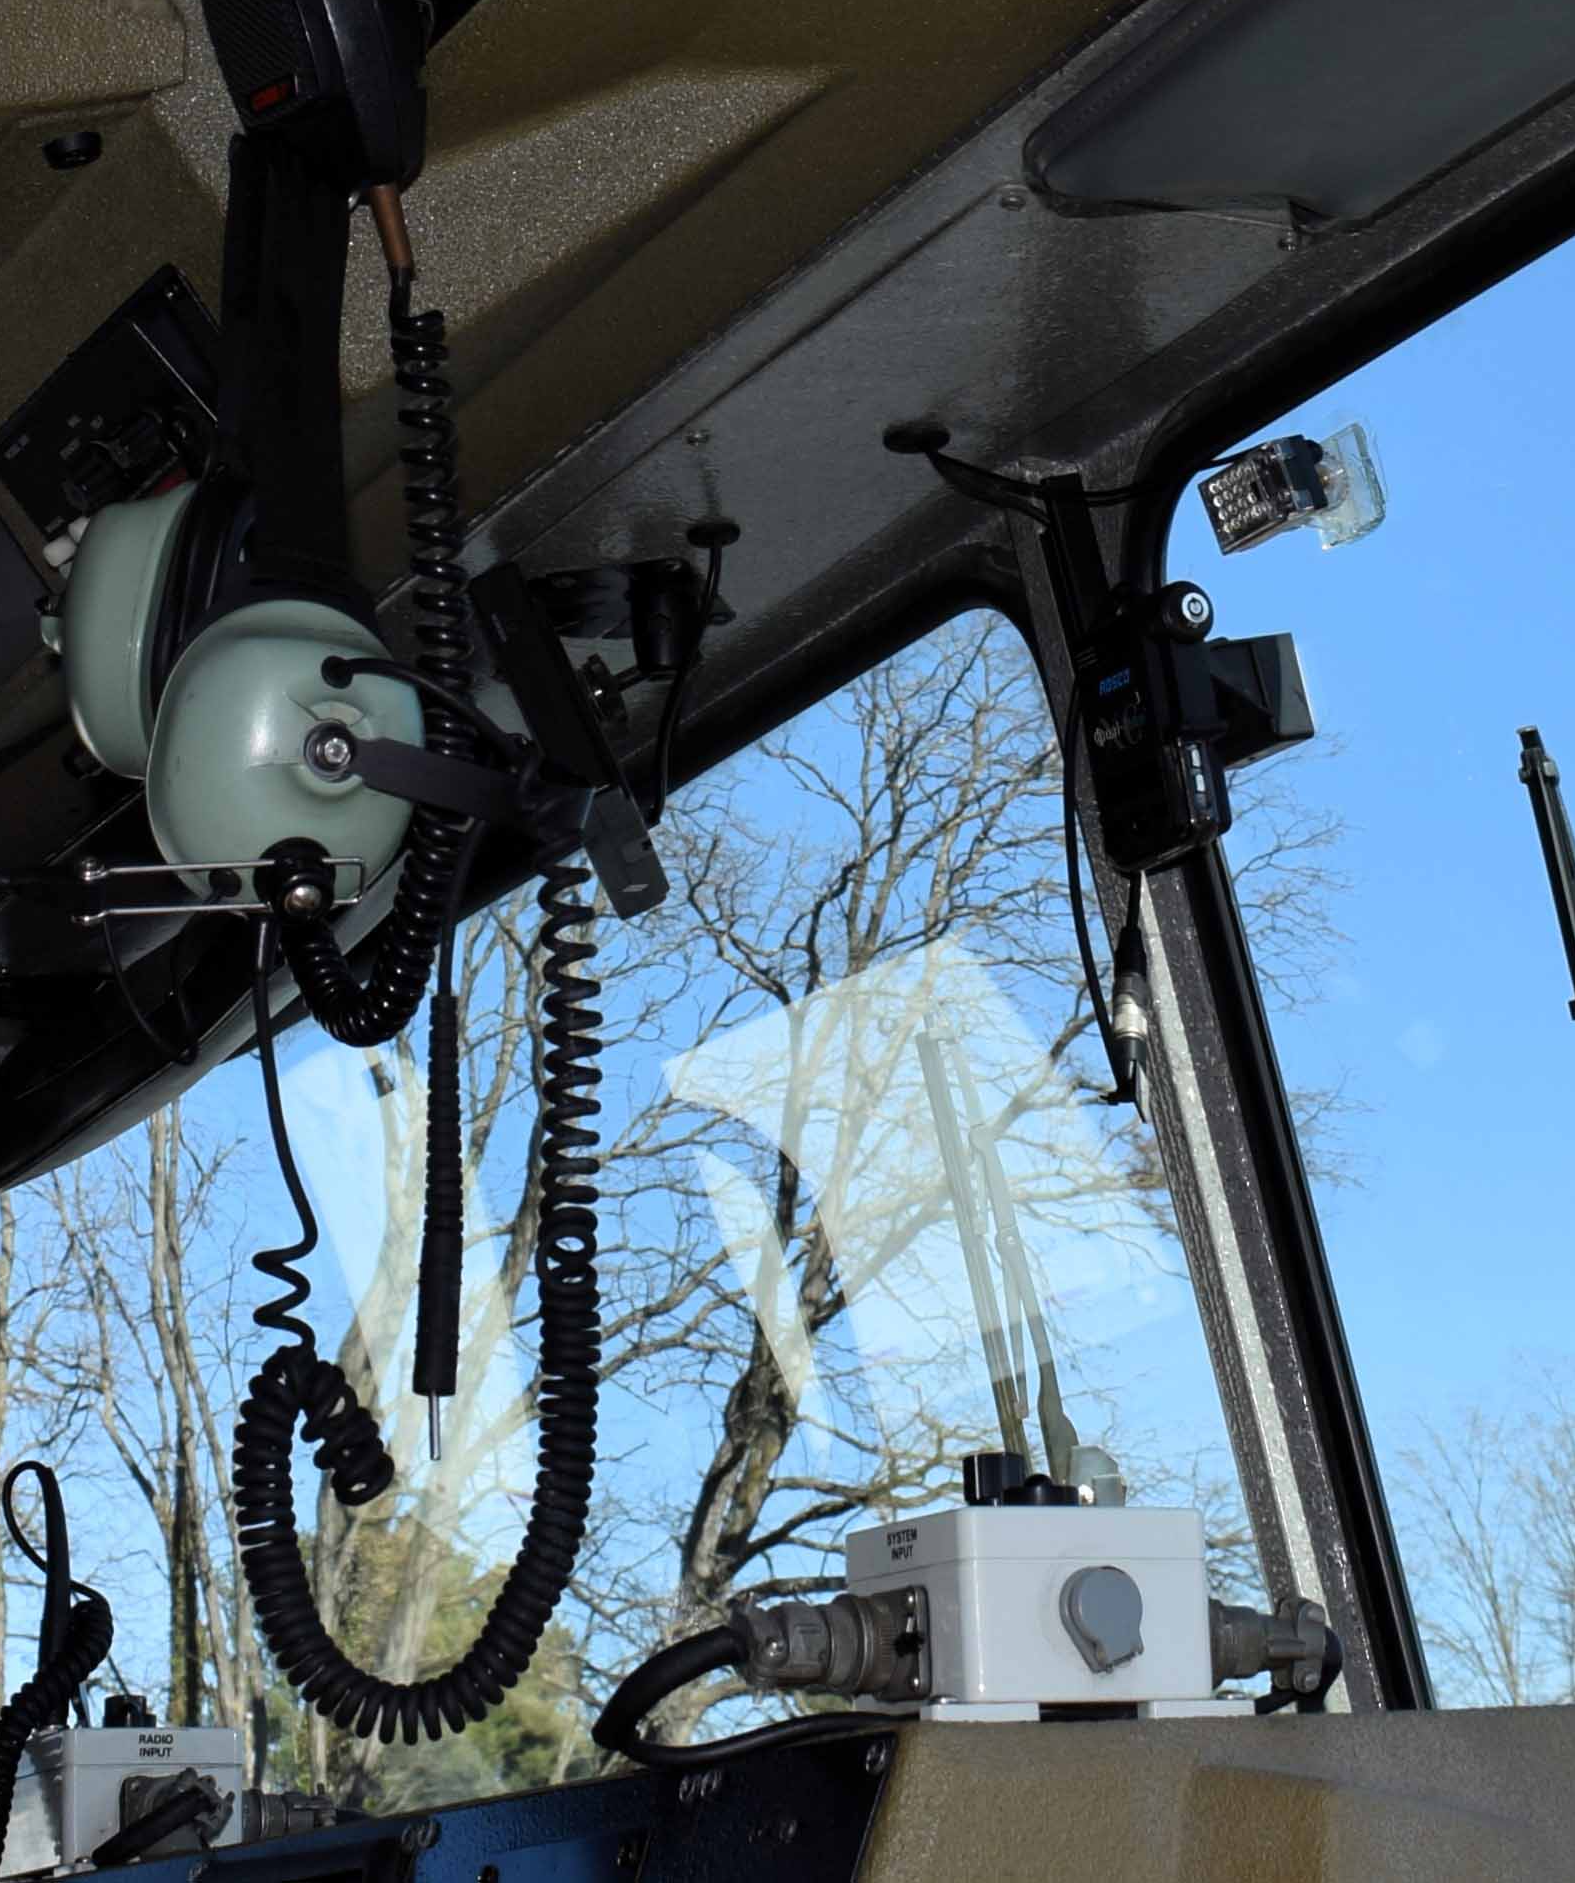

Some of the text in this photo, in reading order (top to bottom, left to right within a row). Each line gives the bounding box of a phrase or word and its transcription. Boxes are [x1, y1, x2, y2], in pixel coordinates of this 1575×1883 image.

[887, 1527, 917, 1546] SYSTEM
[891, 1545, 914, 1561] INPUT
[138, 1733, 174, 1745] RADIO
[138, 1747, 173, 1758] INPUT
